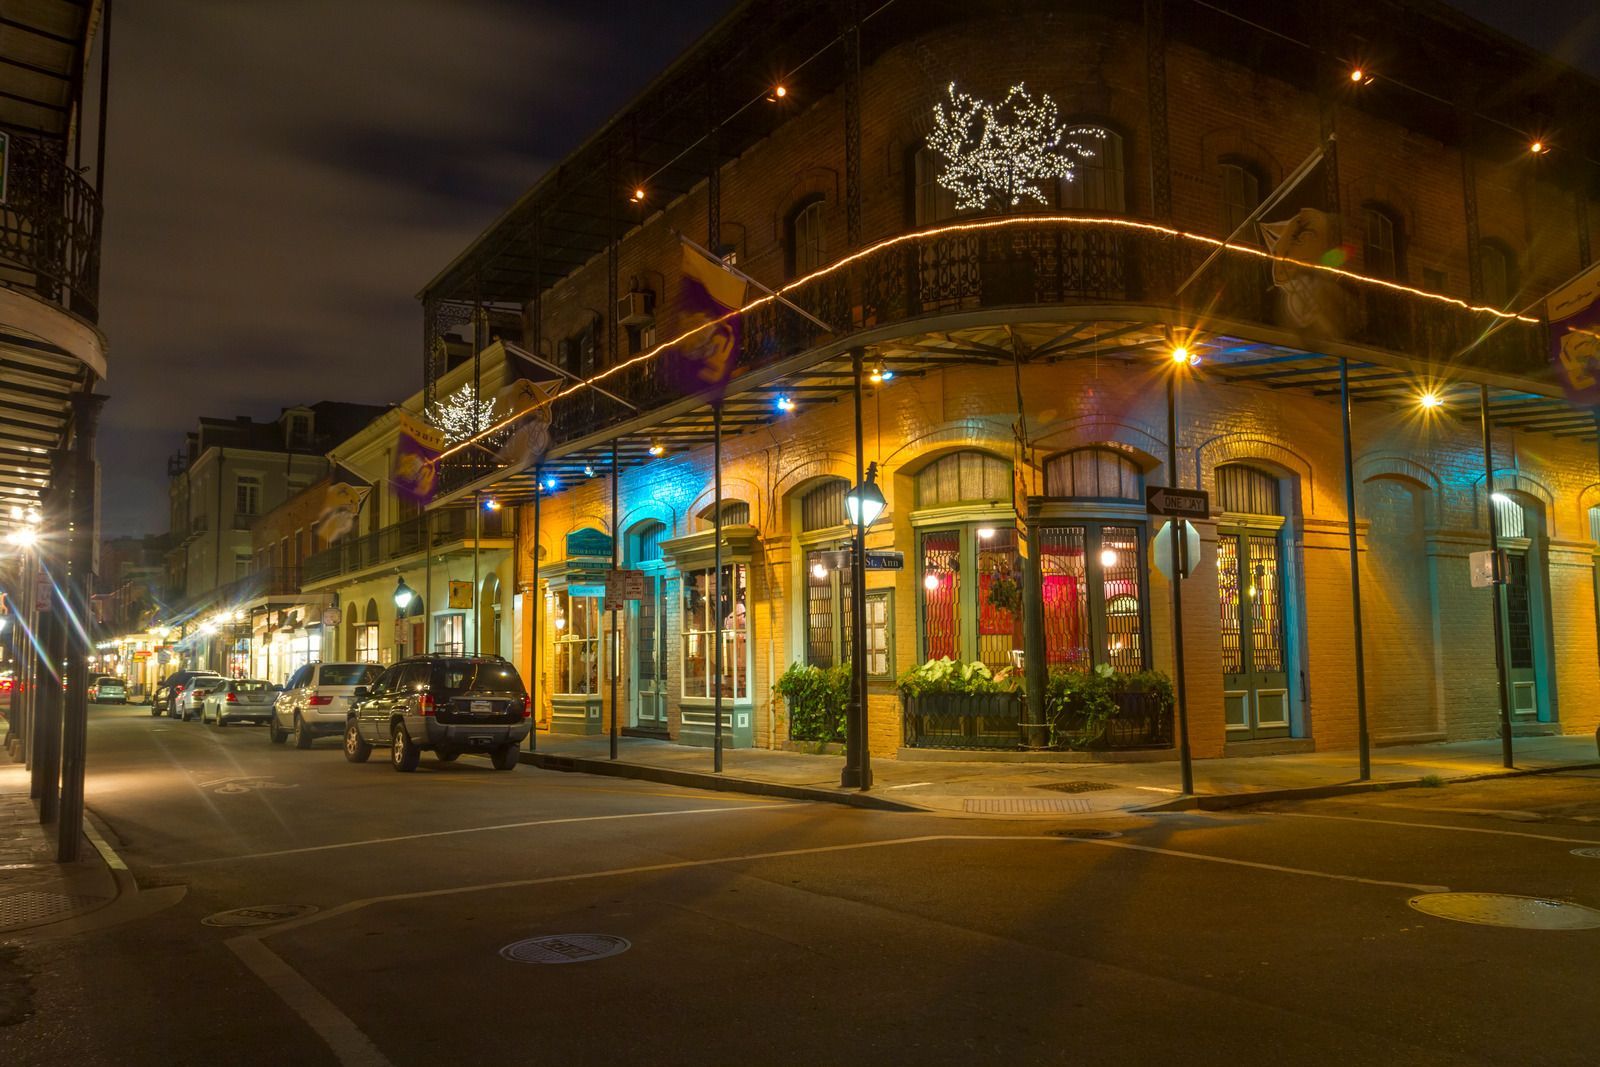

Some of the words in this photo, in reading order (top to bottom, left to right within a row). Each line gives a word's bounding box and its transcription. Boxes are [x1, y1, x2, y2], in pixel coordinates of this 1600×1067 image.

[1164, 496, 1182, 508] ONE
[865, 557, 877, 567] St.
[880, 557, 899, 567] Ann
